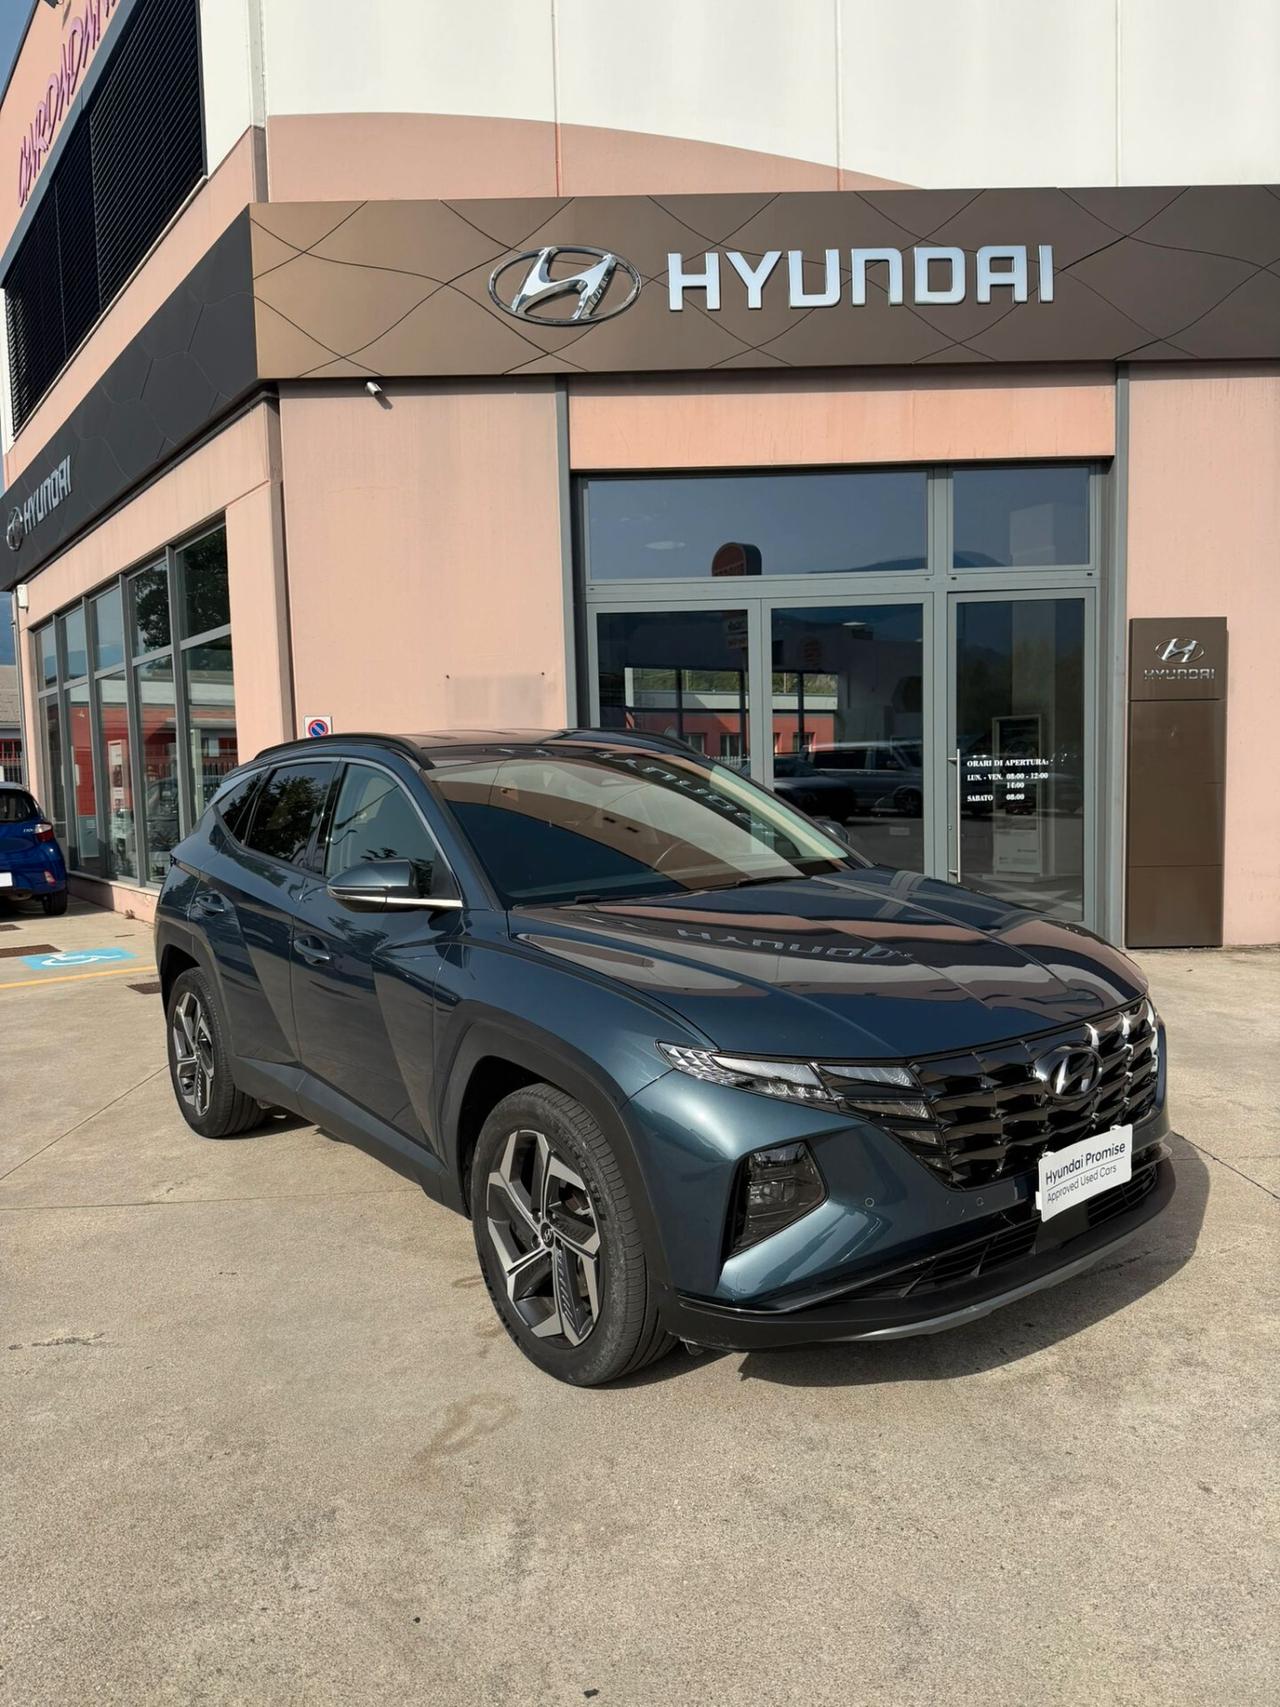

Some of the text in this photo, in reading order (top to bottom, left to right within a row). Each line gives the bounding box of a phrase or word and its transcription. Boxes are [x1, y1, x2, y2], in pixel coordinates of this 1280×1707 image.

[667, 245, 1054, 311] HYUNDAI
[23, 455, 72, 534] HYUNDAI
[1144, 668, 1215, 680] HYUNDAI
[967, 760, 992, 768] ORARI
[967, 794, 994, 802] SABATO
[1045, 1143, 1125, 1185] Hyundai Promise
[1047, 1165, 1117, 1204] Approved Used Cars
